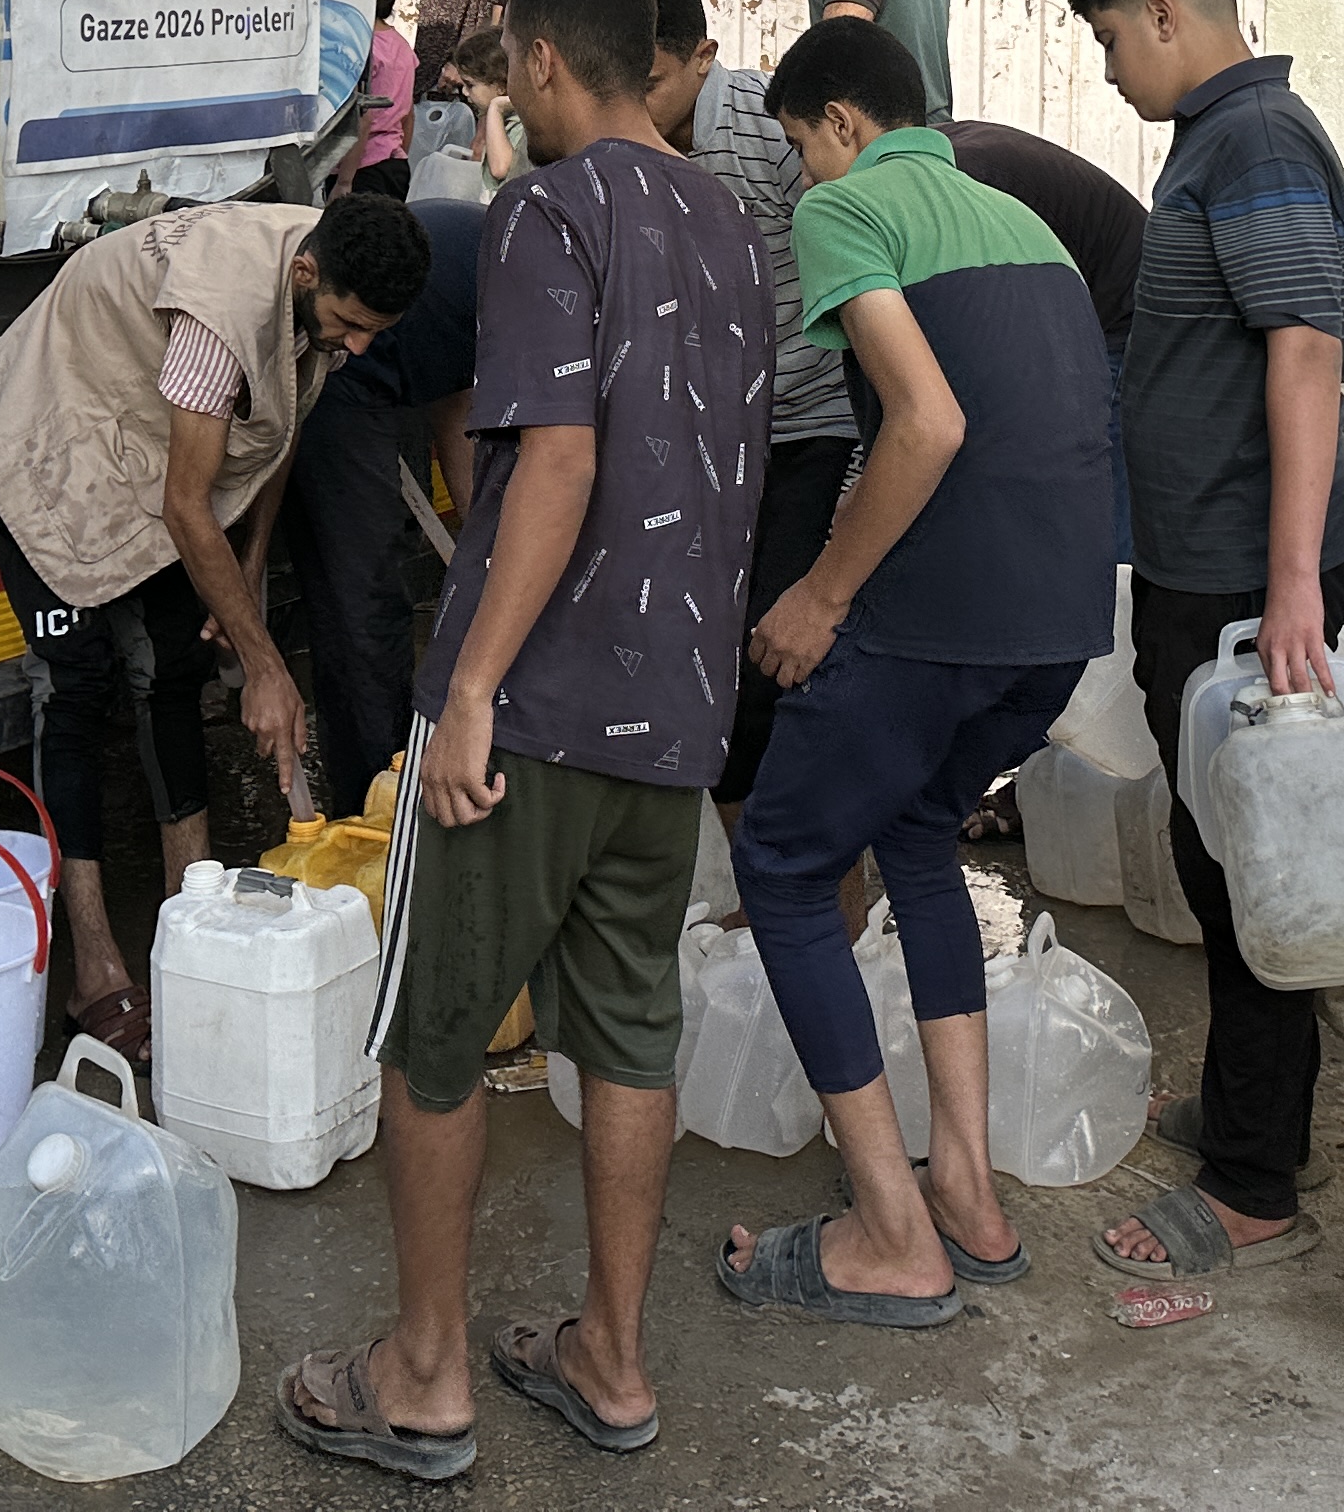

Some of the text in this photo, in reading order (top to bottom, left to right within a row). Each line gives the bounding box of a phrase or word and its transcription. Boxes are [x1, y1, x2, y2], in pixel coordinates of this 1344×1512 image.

[80, 4, 296, 42] Gazze 2026 Projeleri
[556, 359, 590, 377] TERREX
[646, 511, 680, 528] TERREX
[640, 579, 650, 613] adidas
[684, 592, 702, 623] TERREX
[608, 723, 648, 735] TERREX
